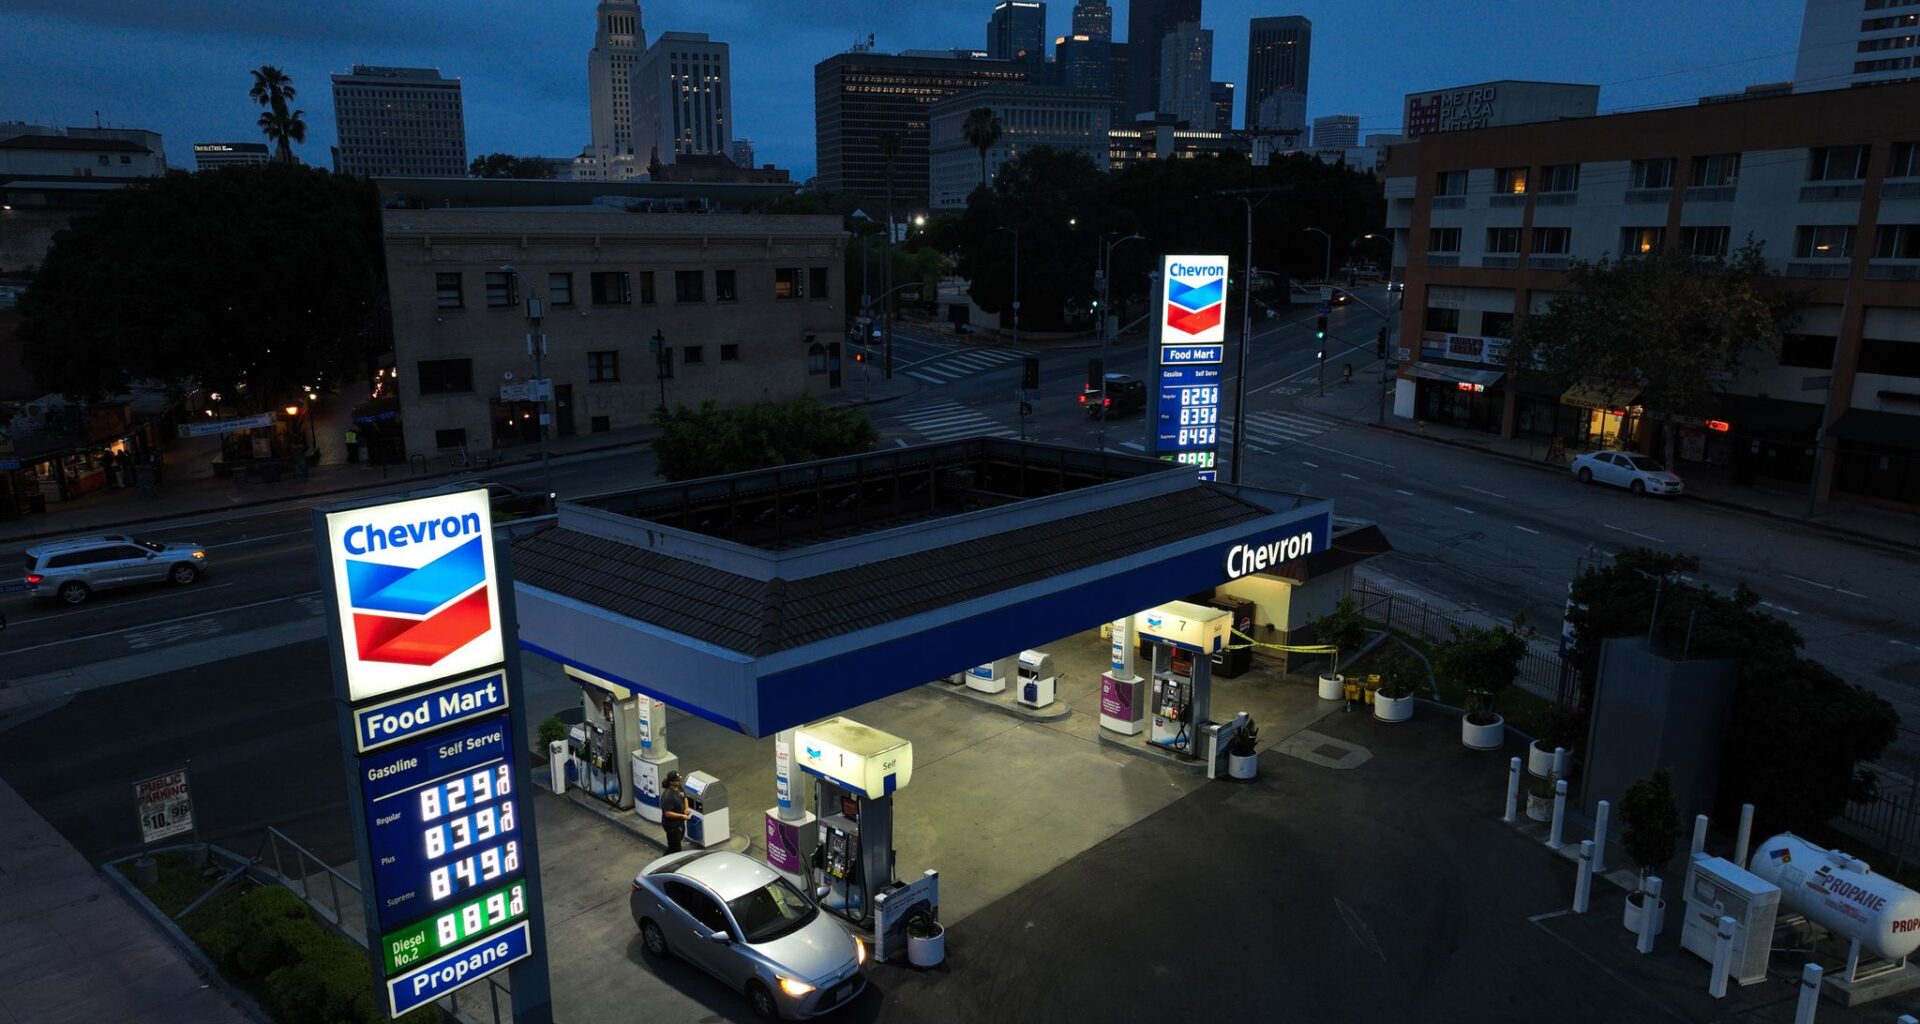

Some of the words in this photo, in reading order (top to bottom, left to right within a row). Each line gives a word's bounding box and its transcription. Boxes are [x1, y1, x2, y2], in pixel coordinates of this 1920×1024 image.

[1441, 87, 1495, 106] METRO
[1441, 104, 1492, 121] PLAZA
[1169, 263, 1224, 276] Chevron
[1170, 350, 1191, 359] Food
[1194, 350, 1214, 358] Mart
[1182, 388, 1210, 405] 829
[1180, 408, 1208, 425] 839
[1179, 428, 1207, 445] 849
[344, 512, 481, 555] Chevron
[1227, 531, 1312, 578] Chevron
[1179, 620, 1187, 632] 7
[367, 703, 430, 739] Food
[439, 682, 498, 719] Mart
[368, 757, 418, 782] Gasoline
[439, 741, 463, 758] Self
[466, 732, 500, 750] Serve
[840, 754, 844, 768] 1
[882, 759, 896, 770] Self
[141, 775, 182, 793] PUBLIC
[138, 784, 188, 806] PARKING
[376, 811, 402, 826] Regular
[420, 769, 493, 822] 829
[382, 856, 396, 866] Plus
[425, 807, 496, 860] 839
[386, 891, 415, 907] Supreme
[430, 847, 502, 901] 849
[1821, 874, 1887, 912] PROPANE
[392, 931, 426, 955] Diesel
[437, 893, 506, 948] 889
[394, 948, 419, 968] No.2
[413, 942, 509, 996] Propane
